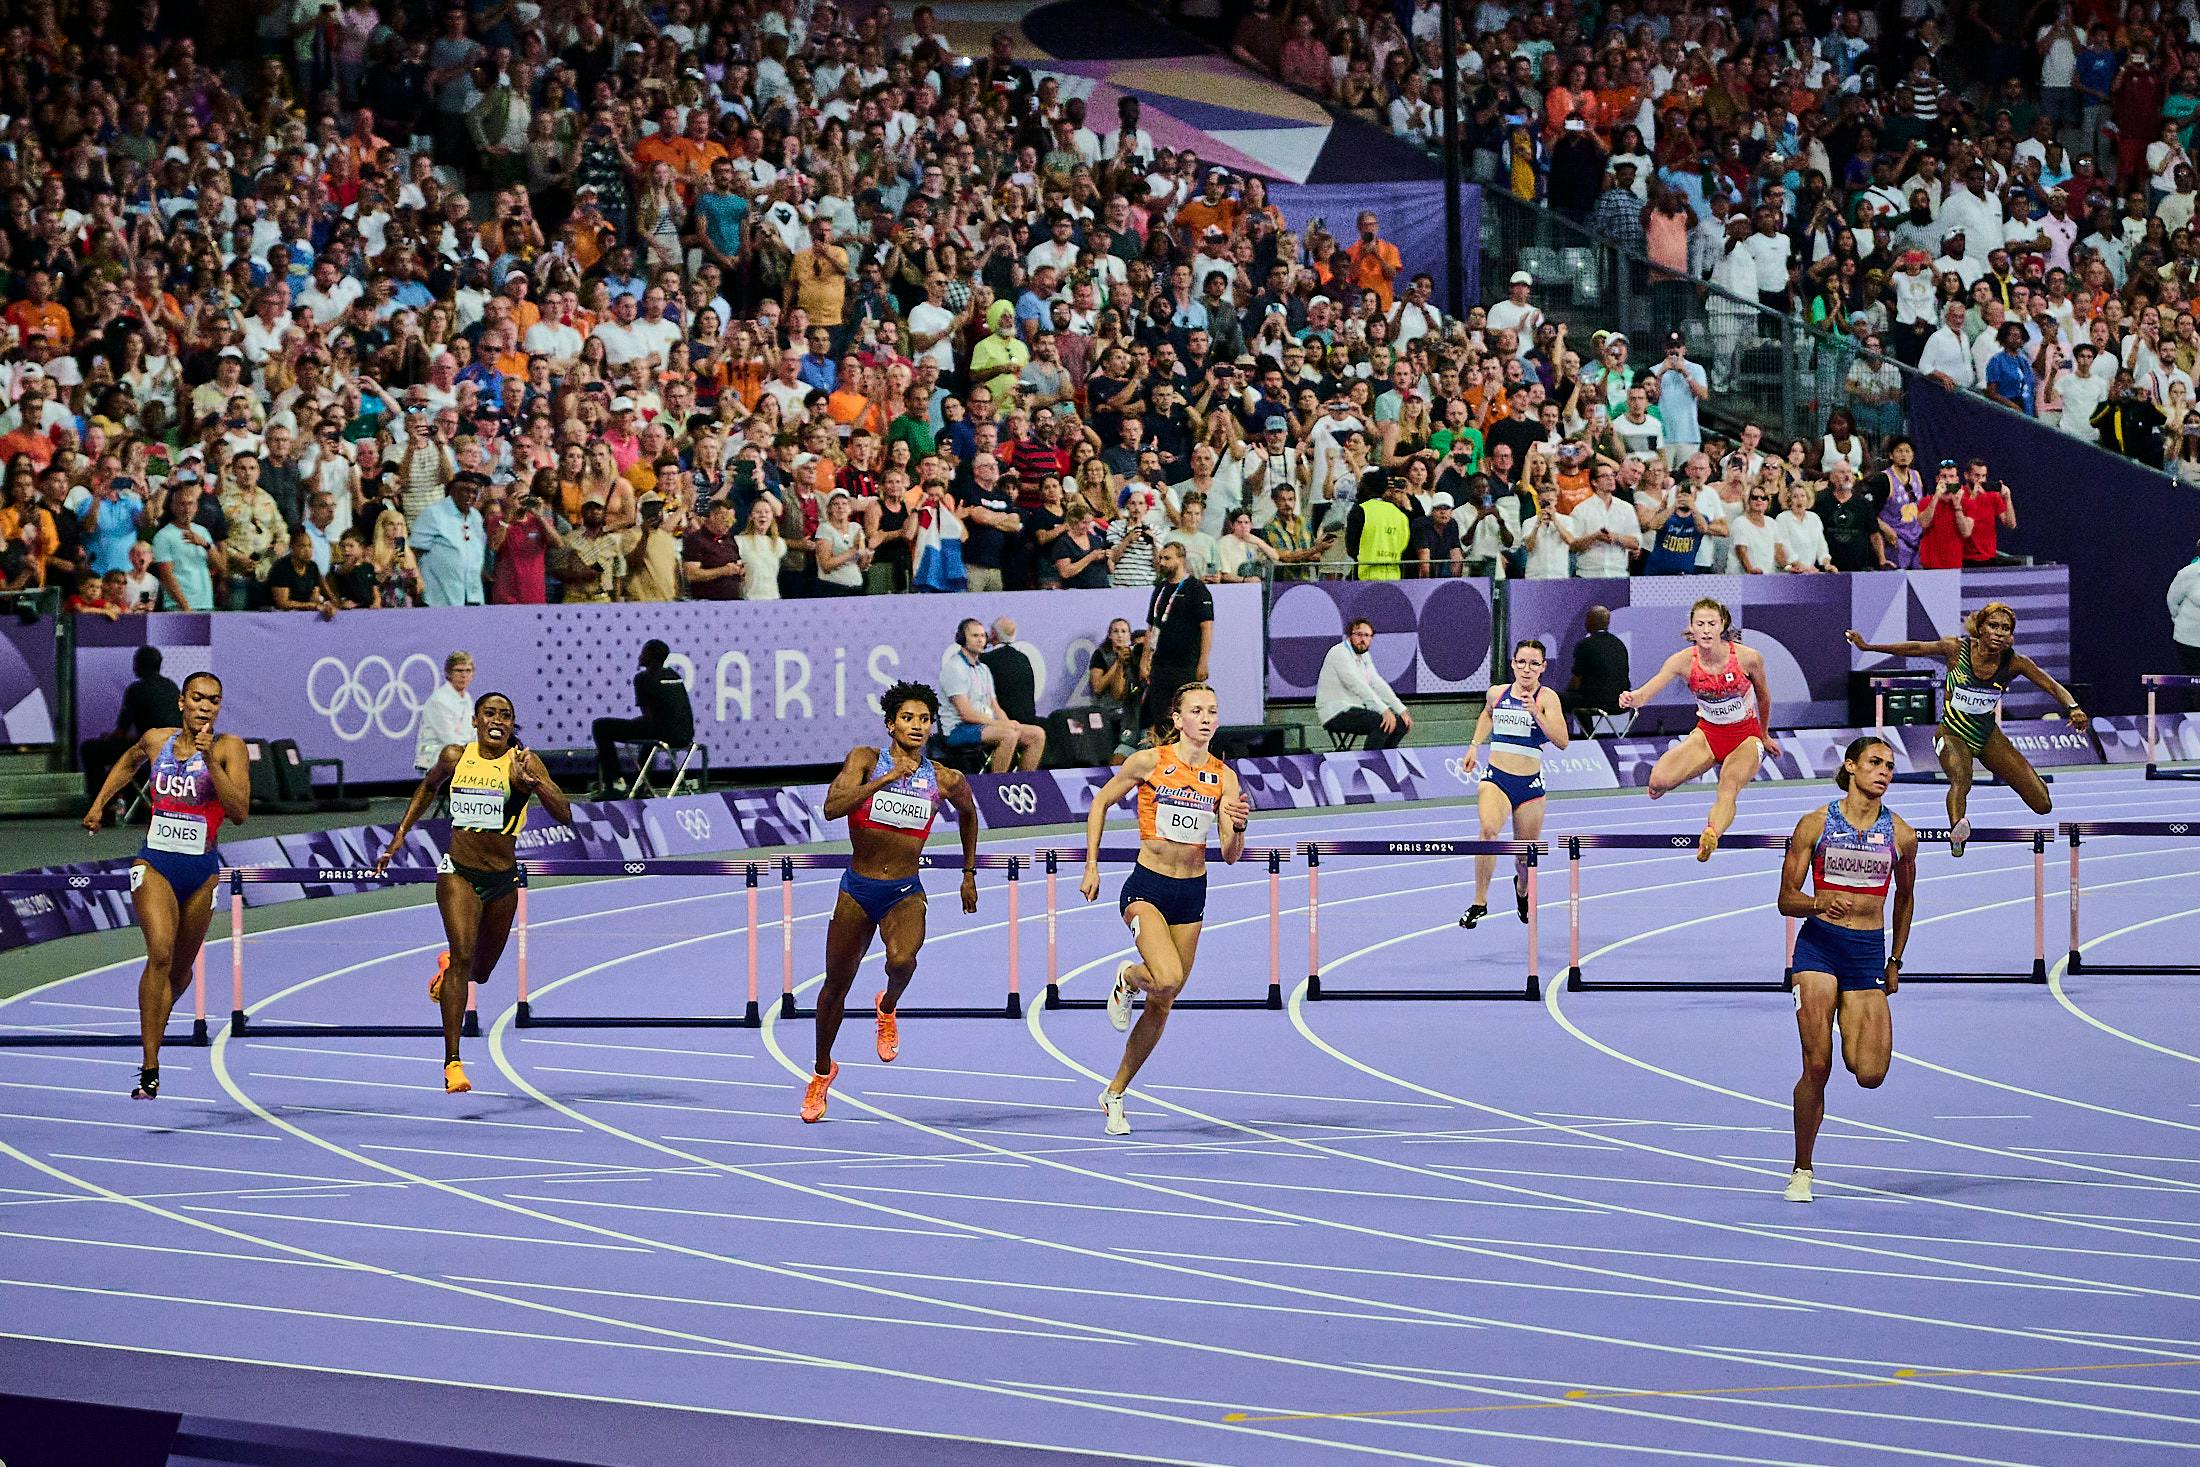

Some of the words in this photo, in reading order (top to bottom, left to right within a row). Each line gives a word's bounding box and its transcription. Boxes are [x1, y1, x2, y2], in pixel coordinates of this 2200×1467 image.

[2050, 734, 2088, 750] 2024
[1561, 758, 1602, 774] 2024
[156, 771, 197, 798] USA
[455, 775, 505, 791] JAMAICA
[452, 801, 501, 815] CLAYTON
[874, 798, 929, 820] COCKRELL
[1171, 814, 1199, 830] BOL
[156, 823, 198, 841] JONES
[541, 825, 576, 845] 2024
[1916, 830, 1933, 839] RIS
[1936, 830, 1951, 839] 20
[1389, 843, 1422, 852] PARIS
[1424, 843, 1454, 852] 2024
[918, 856, 932, 865] 24
[319, 870, 353, 879] PARIS
